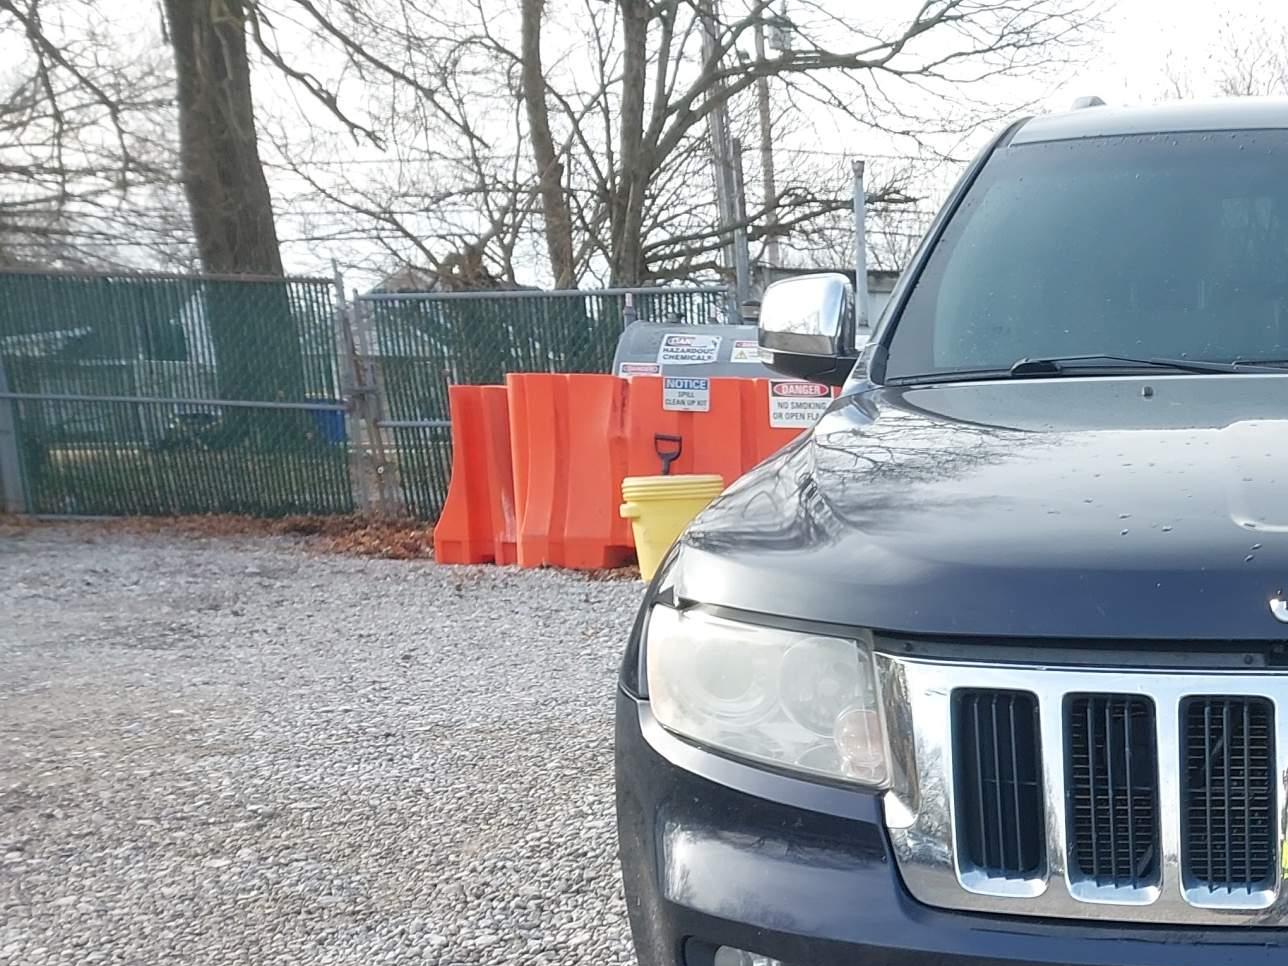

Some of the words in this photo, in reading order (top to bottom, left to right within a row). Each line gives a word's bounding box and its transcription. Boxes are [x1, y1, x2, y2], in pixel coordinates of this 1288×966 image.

[667, 379, 707, 389] NOTICE
[782, 384, 820, 395] DANGER
[665, 398, 686, 406] CLEAN
[777, 401, 789, 409] NO
[791, 401, 827, 410] SMOKING
[773, 412, 783, 420] OR
[784, 412, 805, 421] OPEN
